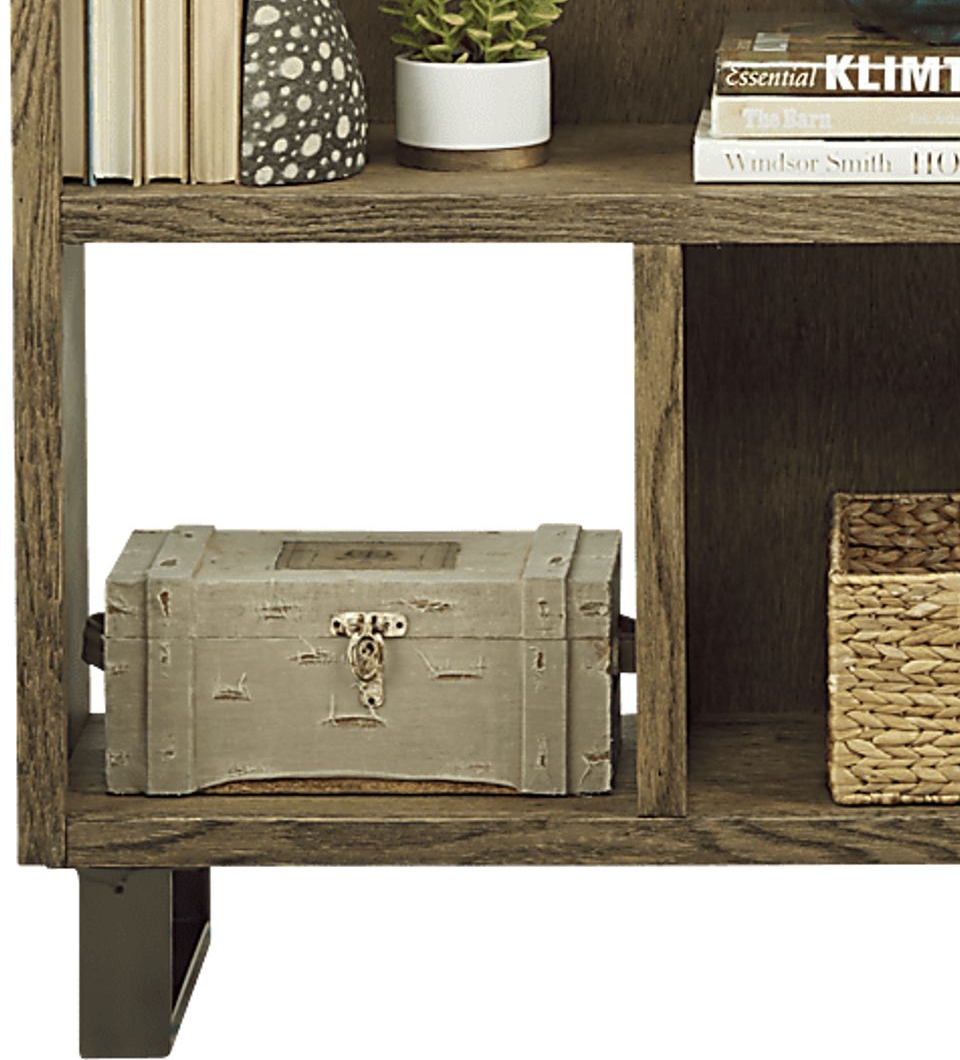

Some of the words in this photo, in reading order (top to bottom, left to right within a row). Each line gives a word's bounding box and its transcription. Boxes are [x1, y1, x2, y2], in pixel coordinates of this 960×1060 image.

[725, 66, 817, 88] Essential
[742, 107, 780, 129] The
[783, 107, 832, 129] Barn
[722, 151, 819, 173] Windsor
[825, 151, 892, 173] Smith
